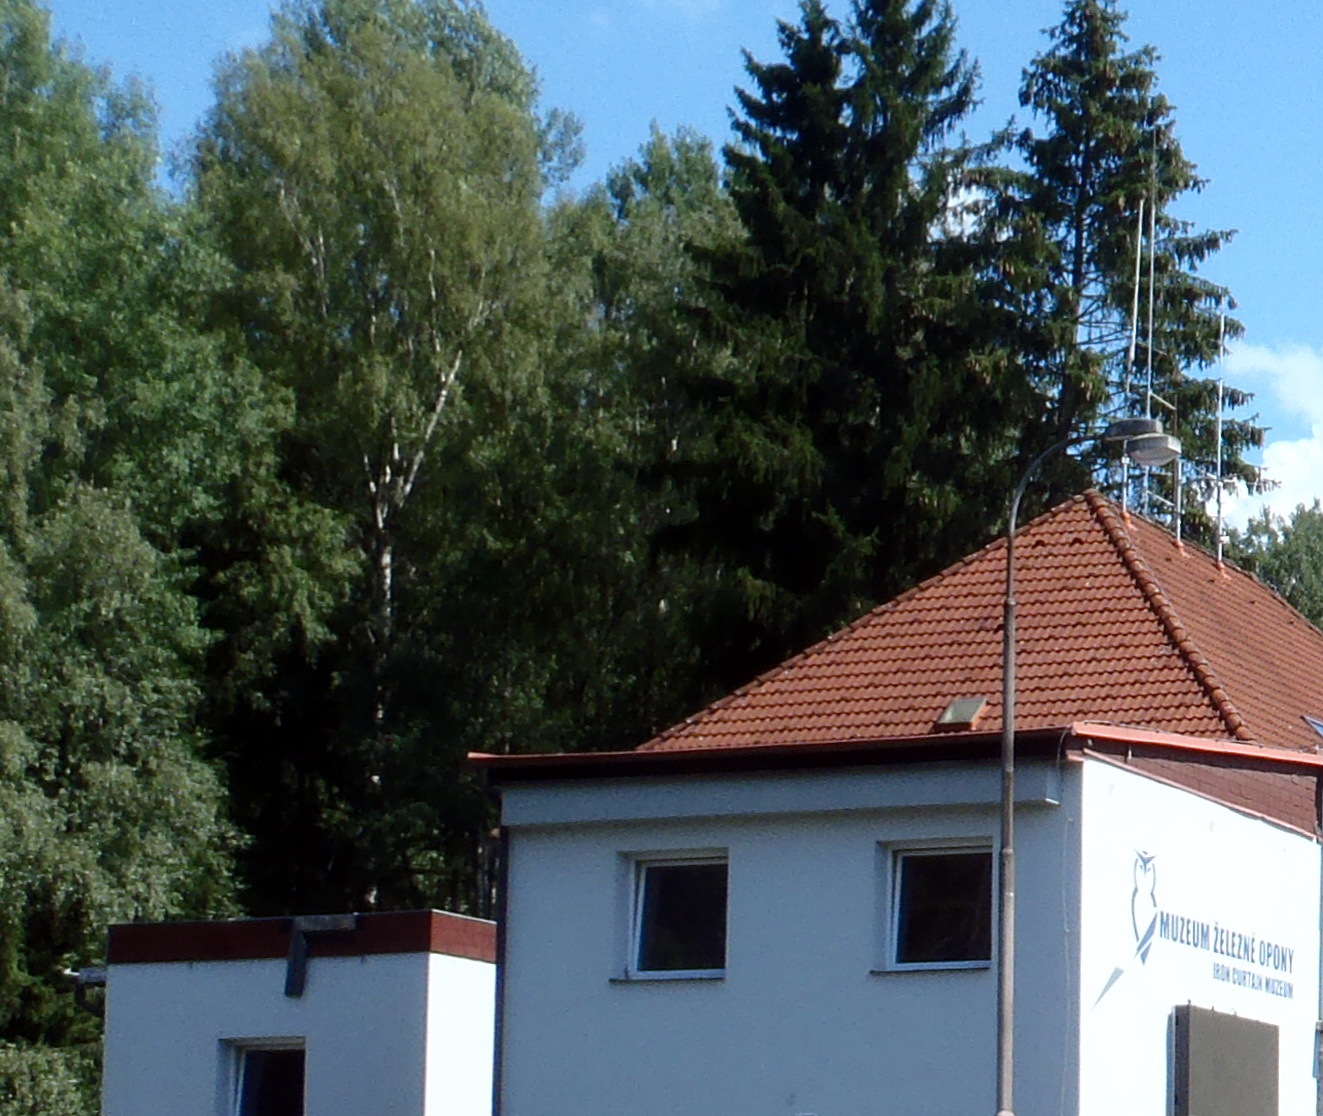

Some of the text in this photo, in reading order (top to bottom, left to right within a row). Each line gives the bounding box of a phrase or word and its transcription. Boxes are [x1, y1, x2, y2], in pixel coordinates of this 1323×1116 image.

[1160, 910, 1294, 974] MUZEUM ŽELEZNÉ OPONY
